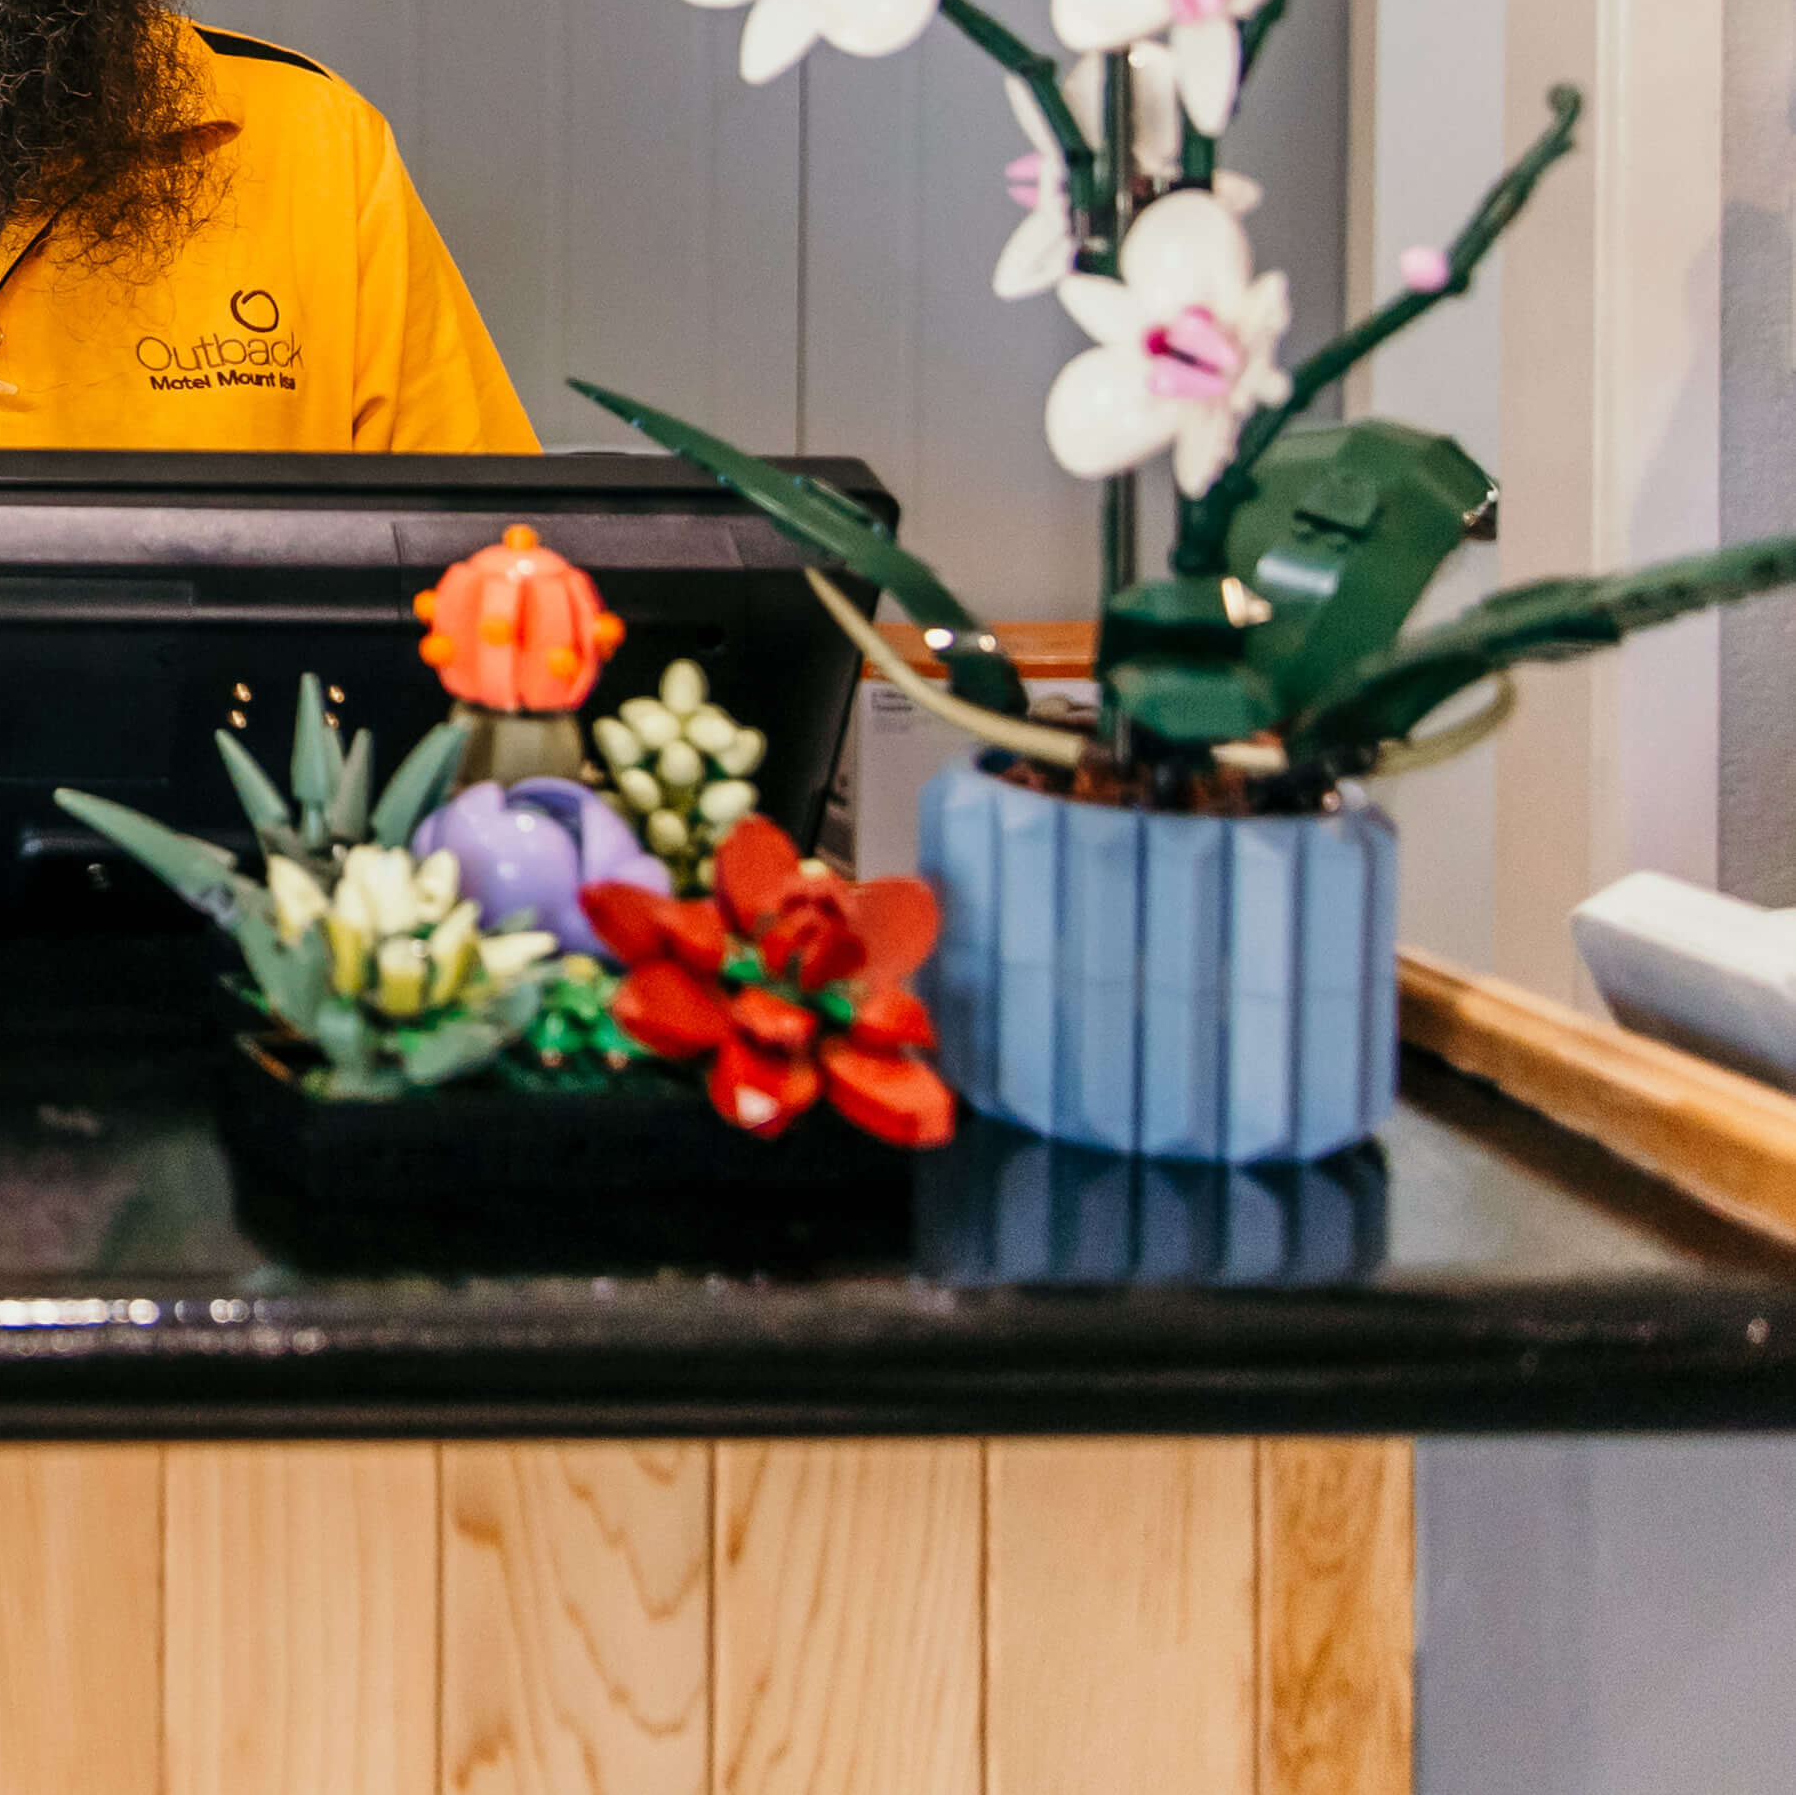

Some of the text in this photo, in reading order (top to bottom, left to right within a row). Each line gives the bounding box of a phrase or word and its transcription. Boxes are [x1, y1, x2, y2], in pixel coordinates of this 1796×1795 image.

[136, 331, 304, 371] Outback
[149, 369, 297, 391] Motel Mount Isa
